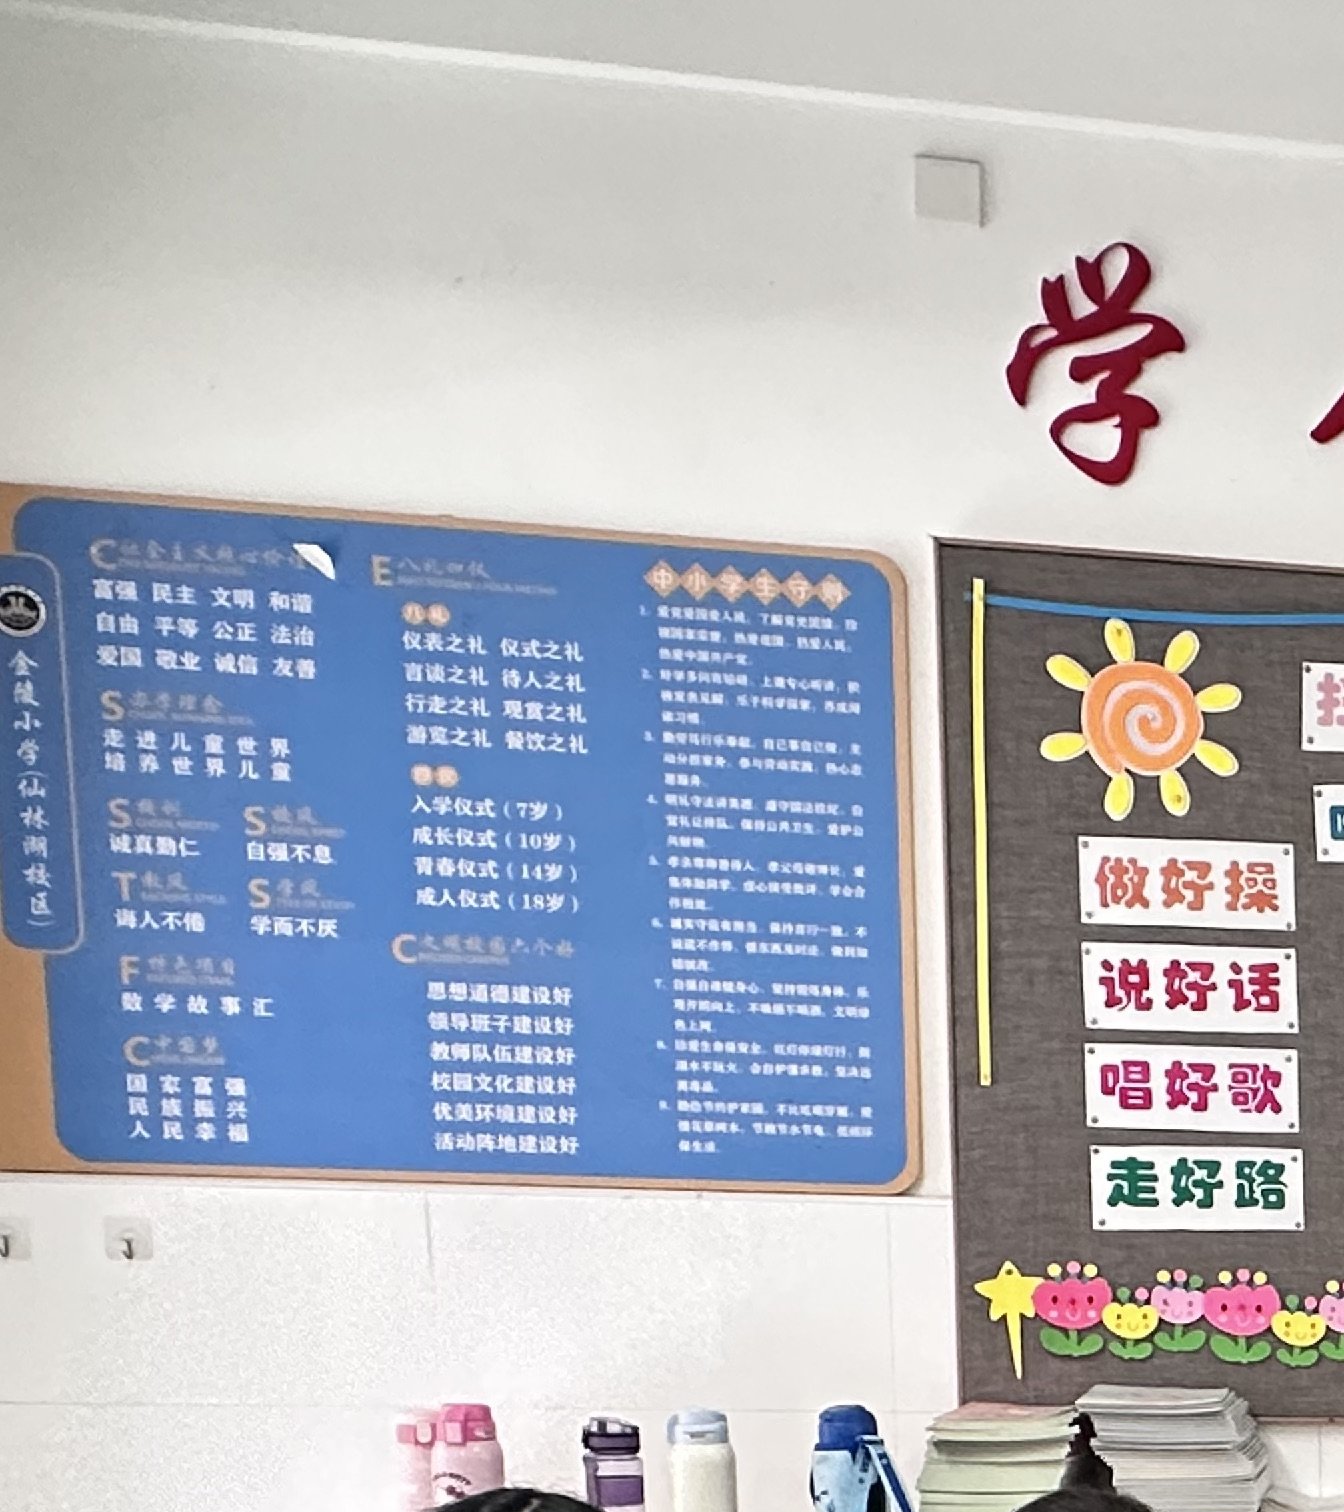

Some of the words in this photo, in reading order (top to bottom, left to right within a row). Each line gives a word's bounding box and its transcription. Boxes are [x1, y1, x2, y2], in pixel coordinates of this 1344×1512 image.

[371, 554, 394, 586] E
[92, 578, 139, 601] 富强
[152, 582, 197, 605] 民主
[210, 586, 255, 609] 文明
[268, 590, 313, 614] 和谐
[96, 611, 140, 635] 自由
[154, 616, 199, 639] 平等
[212, 619, 258, 643] 公正
[270, 623, 315, 647] 法治
[96, 644, 144, 667] 爱国
[155, 649, 201, 672] 敬业
[214, 652, 258, 676] 诚信
[272, 656, 316, 680] 友善
[402, 630, 489, 656] 仪表之礼
[500, 637, 584, 663] 仪式之礼
[403, 662, 489, 687] 言谈之礼
[502, 670, 586, 693] 待人之礼
[100, 690, 125, 722] S
[405, 692, 491, 717] 行走之礼
[503, 699, 588, 724] 观赏之礼
[103, 728, 291, 759] 走进儿童世界
[405, 724, 493, 749] 游览之礼
[504, 730, 589, 755] 餐饮之礼
[104, 752, 292, 782] 培养世界儿童
[108, 798, 133, 829] S
[243, 806, 267, 837] S
[246, 842, 337, 864] 自强不息
[111, 871, 137, 902] T
[248, 878, 272, 909] S
[1094, 857, 1280, 913] 做好操
[250, 915, 340, 939] 学而不厌
[390, 933, 417, 965] C
[119, 955, 140, 985] F
[1100, 960, 1283, 1014] 说好话
[120, 991, 275, 1017] 数学故事汇
[122, 1034, 150, 1067] C
[430, 1041, 576, 1066] 教师队伍建设好
[126, 1073, 246, 1096] 国家富强
[431, 1071, 577, 1096] 校园文化建设好
[1100, 1062, 1283, 1114] 唱好歌
[128, 1096, 248, 1120] 民族振兴
[433, 1101, 578, 1126] 优美环境建设好
[128, 1119, 249, 1143] 人民幸福
[434, 1132, 580, 1156] 活动阵地建设好
[1106, 1157, 1288, 1211] 走好路
